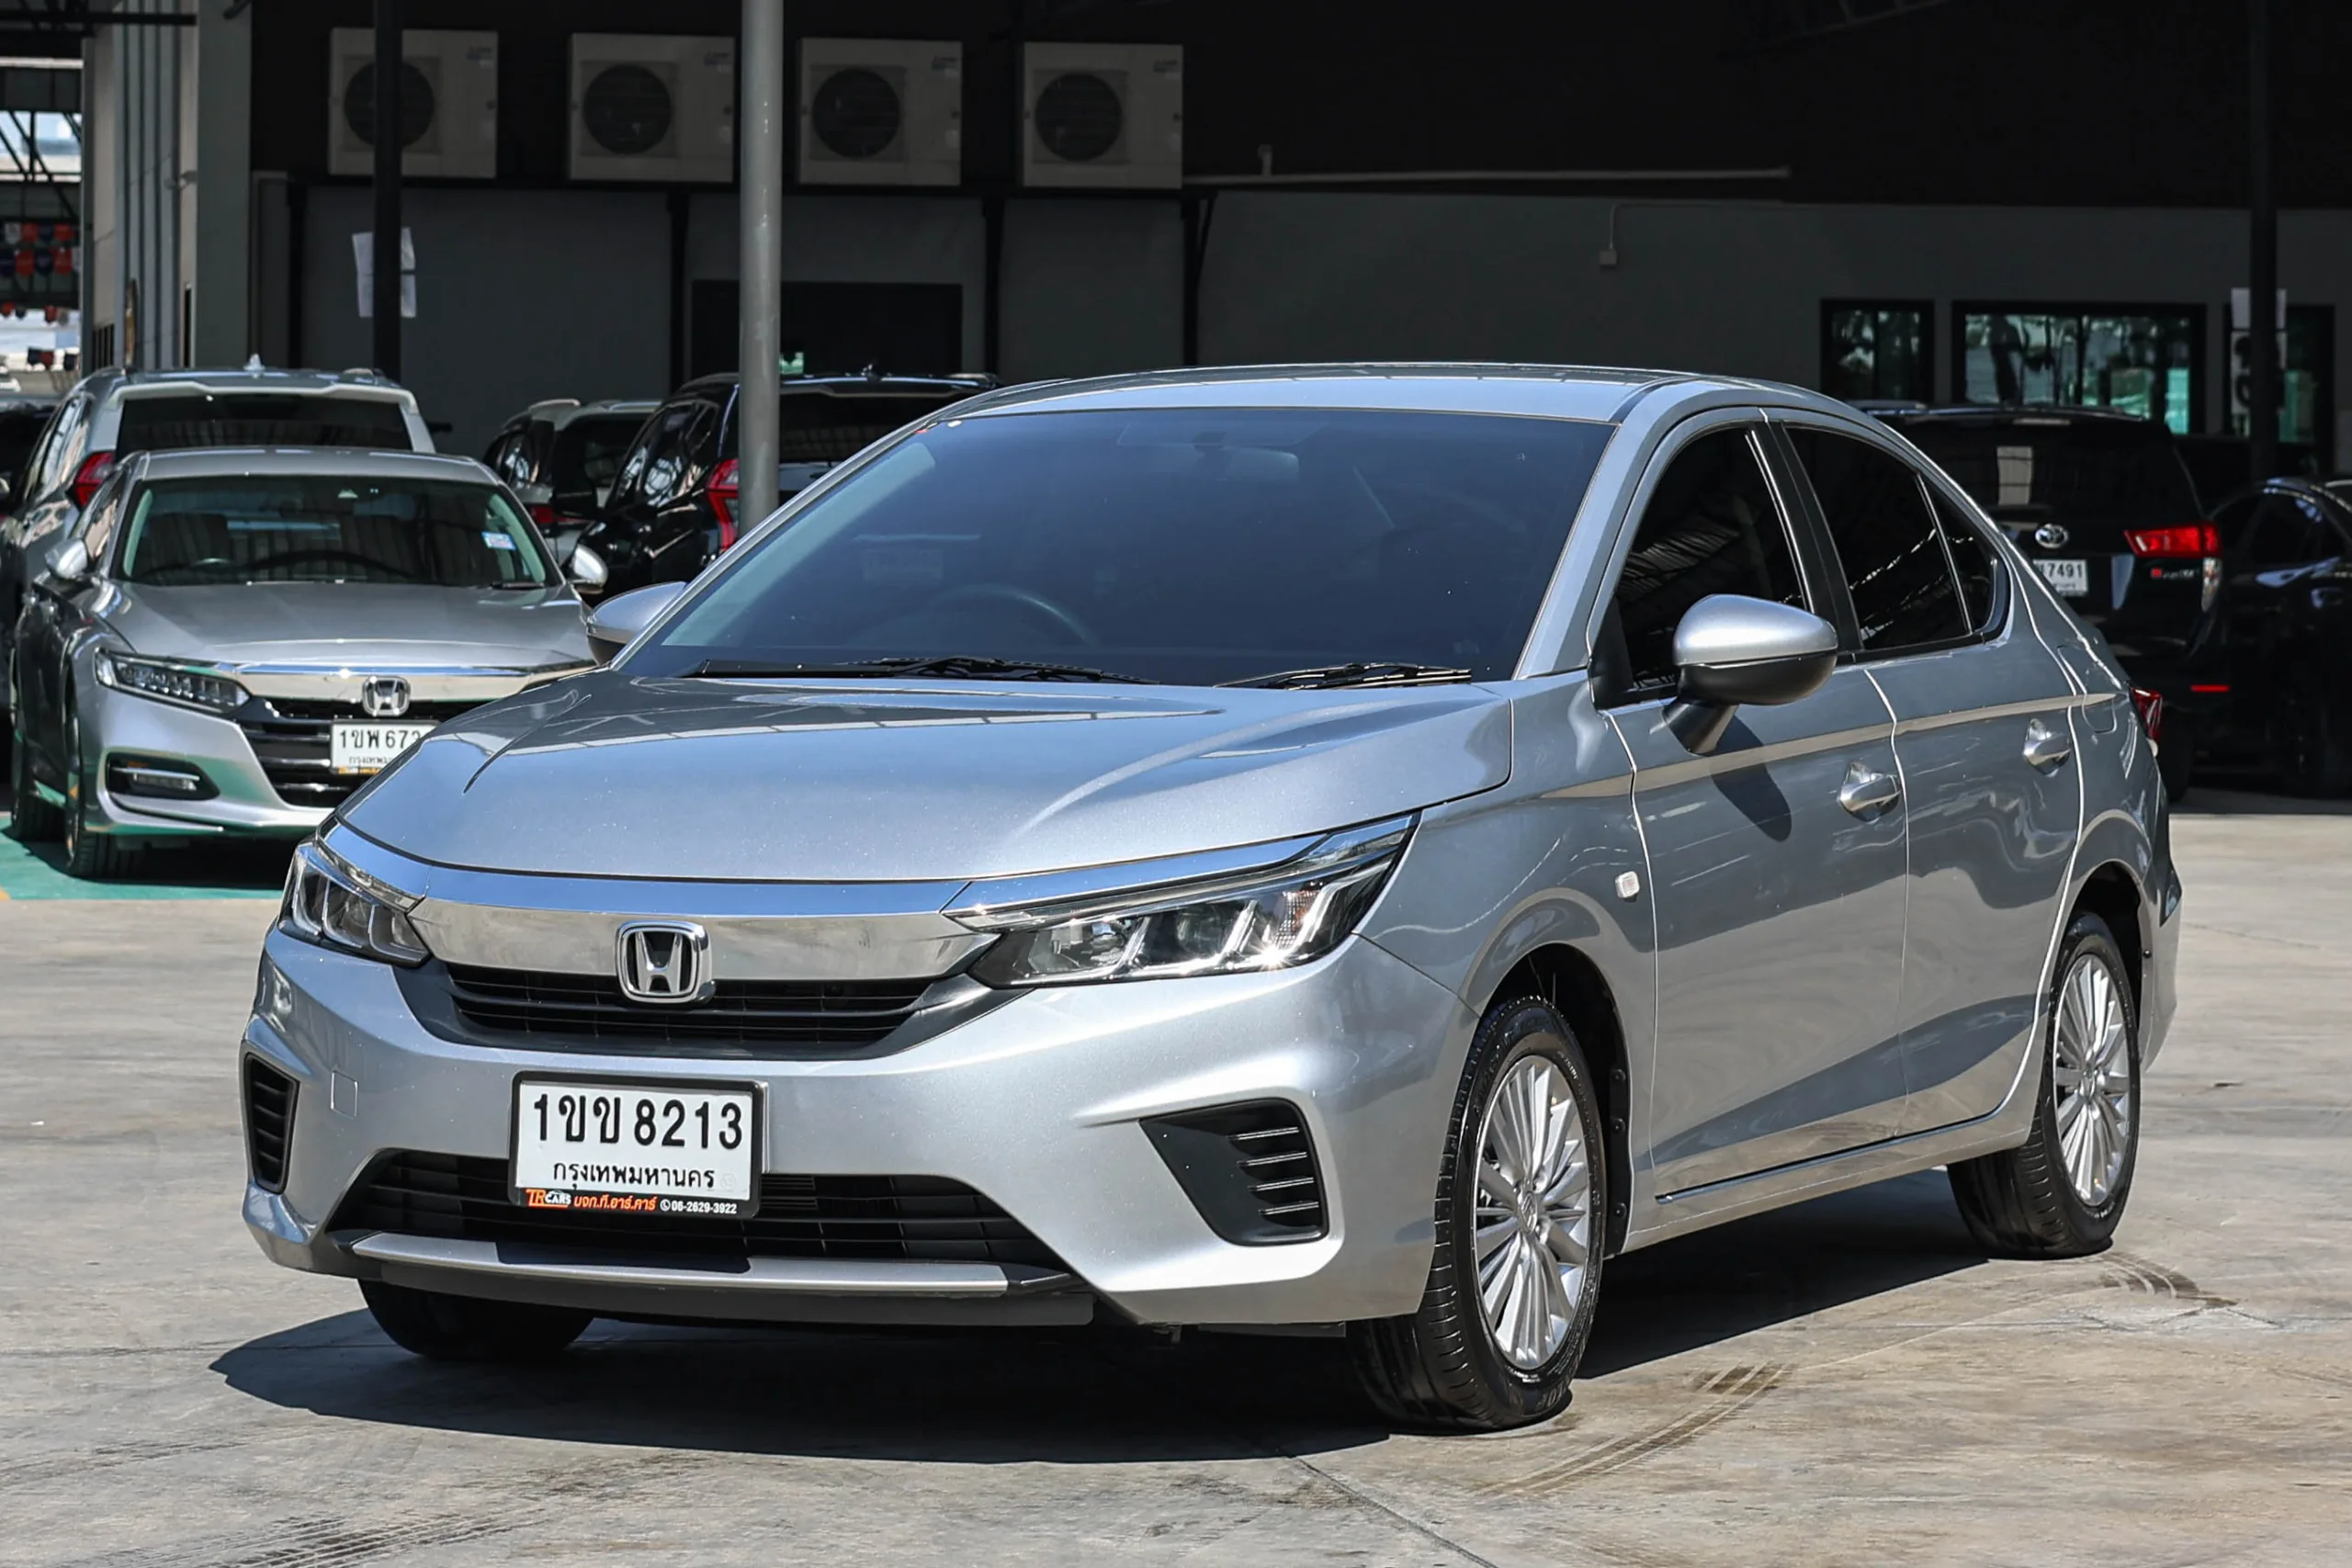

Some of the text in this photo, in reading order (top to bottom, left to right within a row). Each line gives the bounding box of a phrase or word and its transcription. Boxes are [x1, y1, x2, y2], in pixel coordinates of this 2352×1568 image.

[534, 1093, 742, 1150] 1ขข 8213
[553, 1161, 715, 1190] กรุงเทพมหานคร
